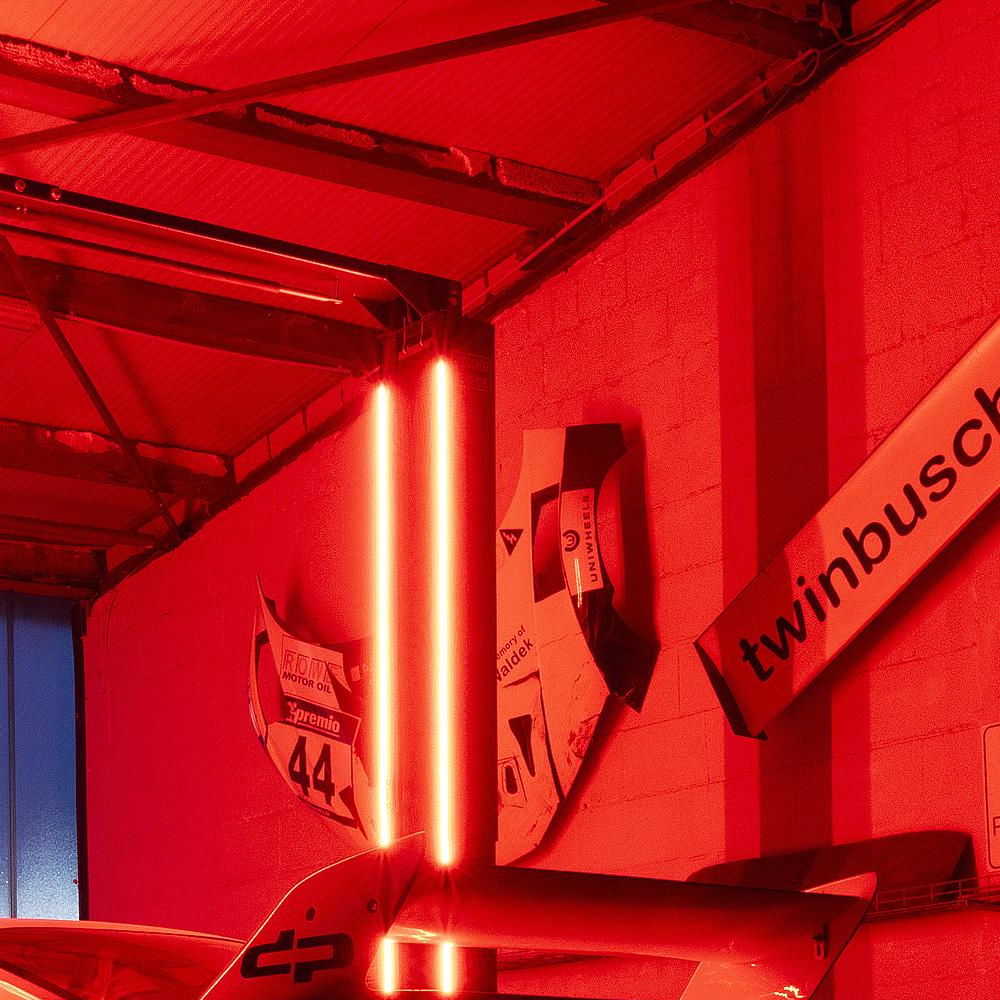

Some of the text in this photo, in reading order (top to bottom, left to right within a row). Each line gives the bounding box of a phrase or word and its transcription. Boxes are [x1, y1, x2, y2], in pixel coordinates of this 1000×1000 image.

[582, 494, 598, 583] UNIWHEELS
[496, 635, 518, 661] emory
[282, 670, 332, 695] MOTOR OIL
[295, 708, 341, 733] premio
[287, 735, 336, 807] 44
